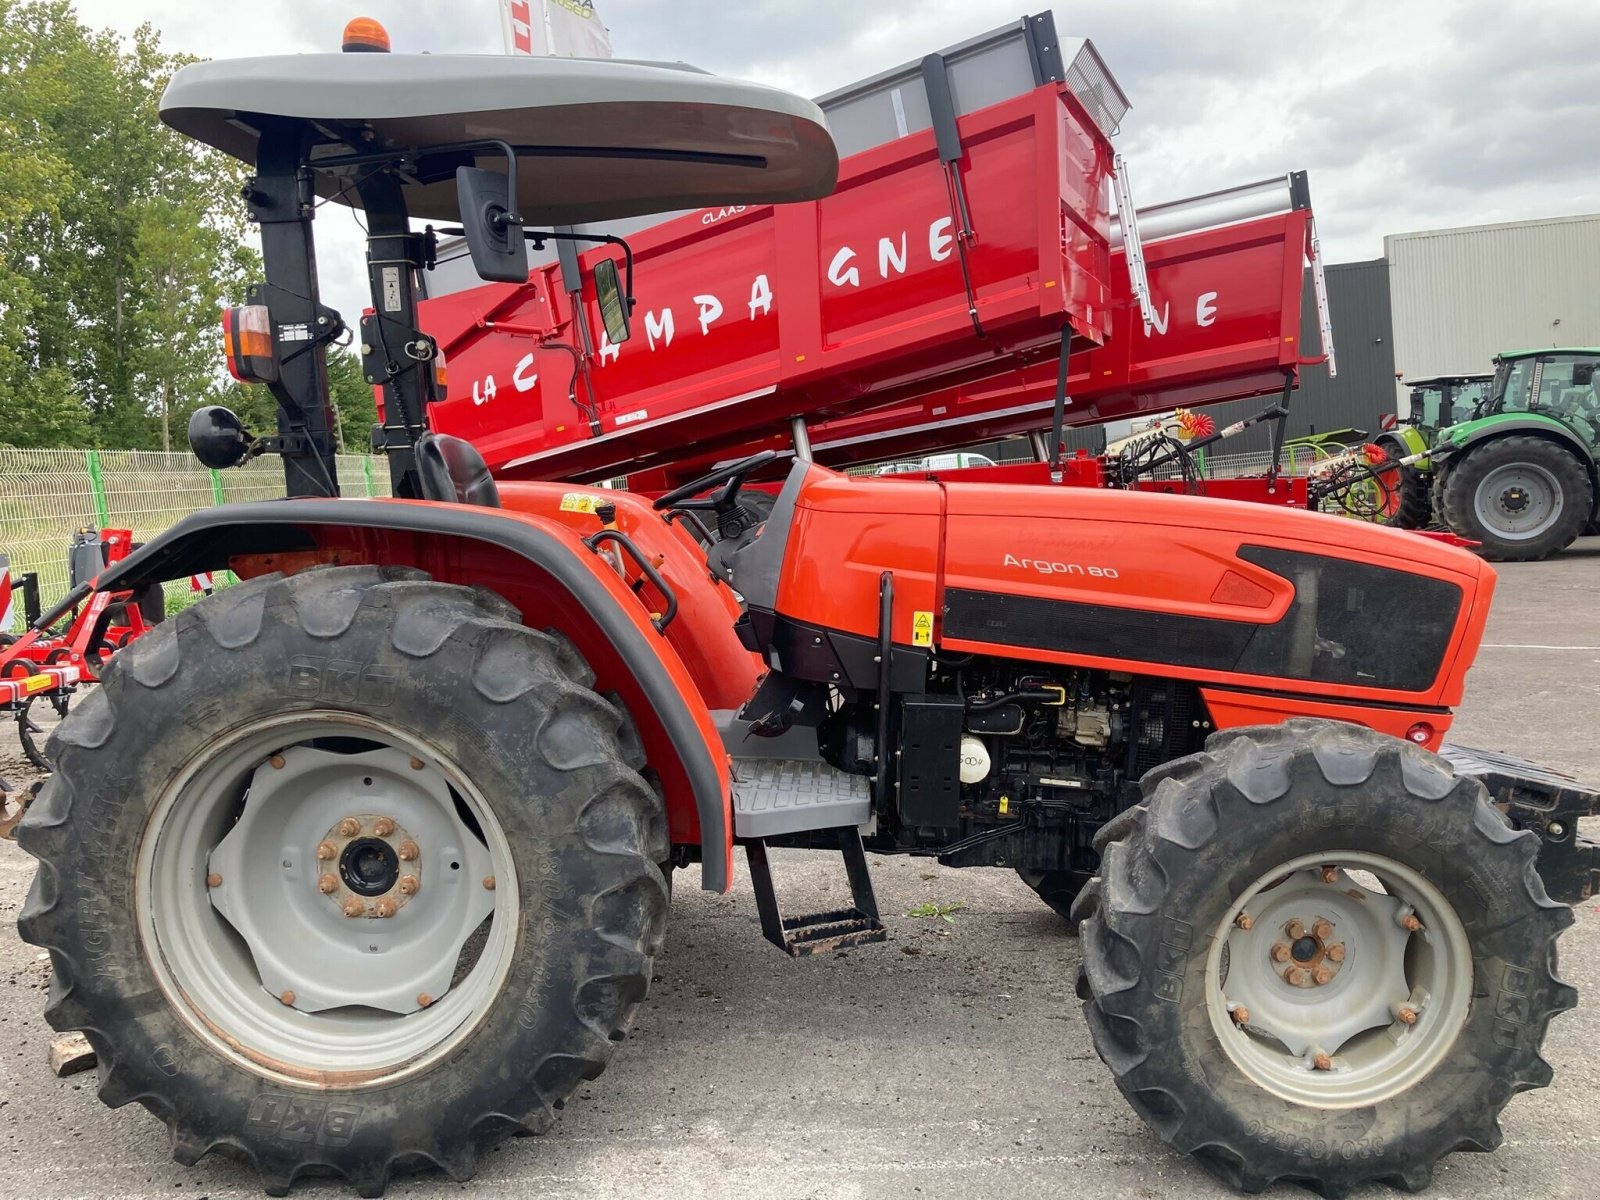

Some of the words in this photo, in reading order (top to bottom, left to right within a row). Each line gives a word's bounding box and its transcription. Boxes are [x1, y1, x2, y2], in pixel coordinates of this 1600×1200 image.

[473, 375, 497, 406] LA
[1003, 553, 1085, 575] Argon
[1087, 566, 1119, 579] 80
[287, 655, 401, 707] BKT
[1153, 914, 1192, 1004] BKT
[1491, 963, 1535, 1050] BKT
[246, 1093, 365, 1147] BKT
